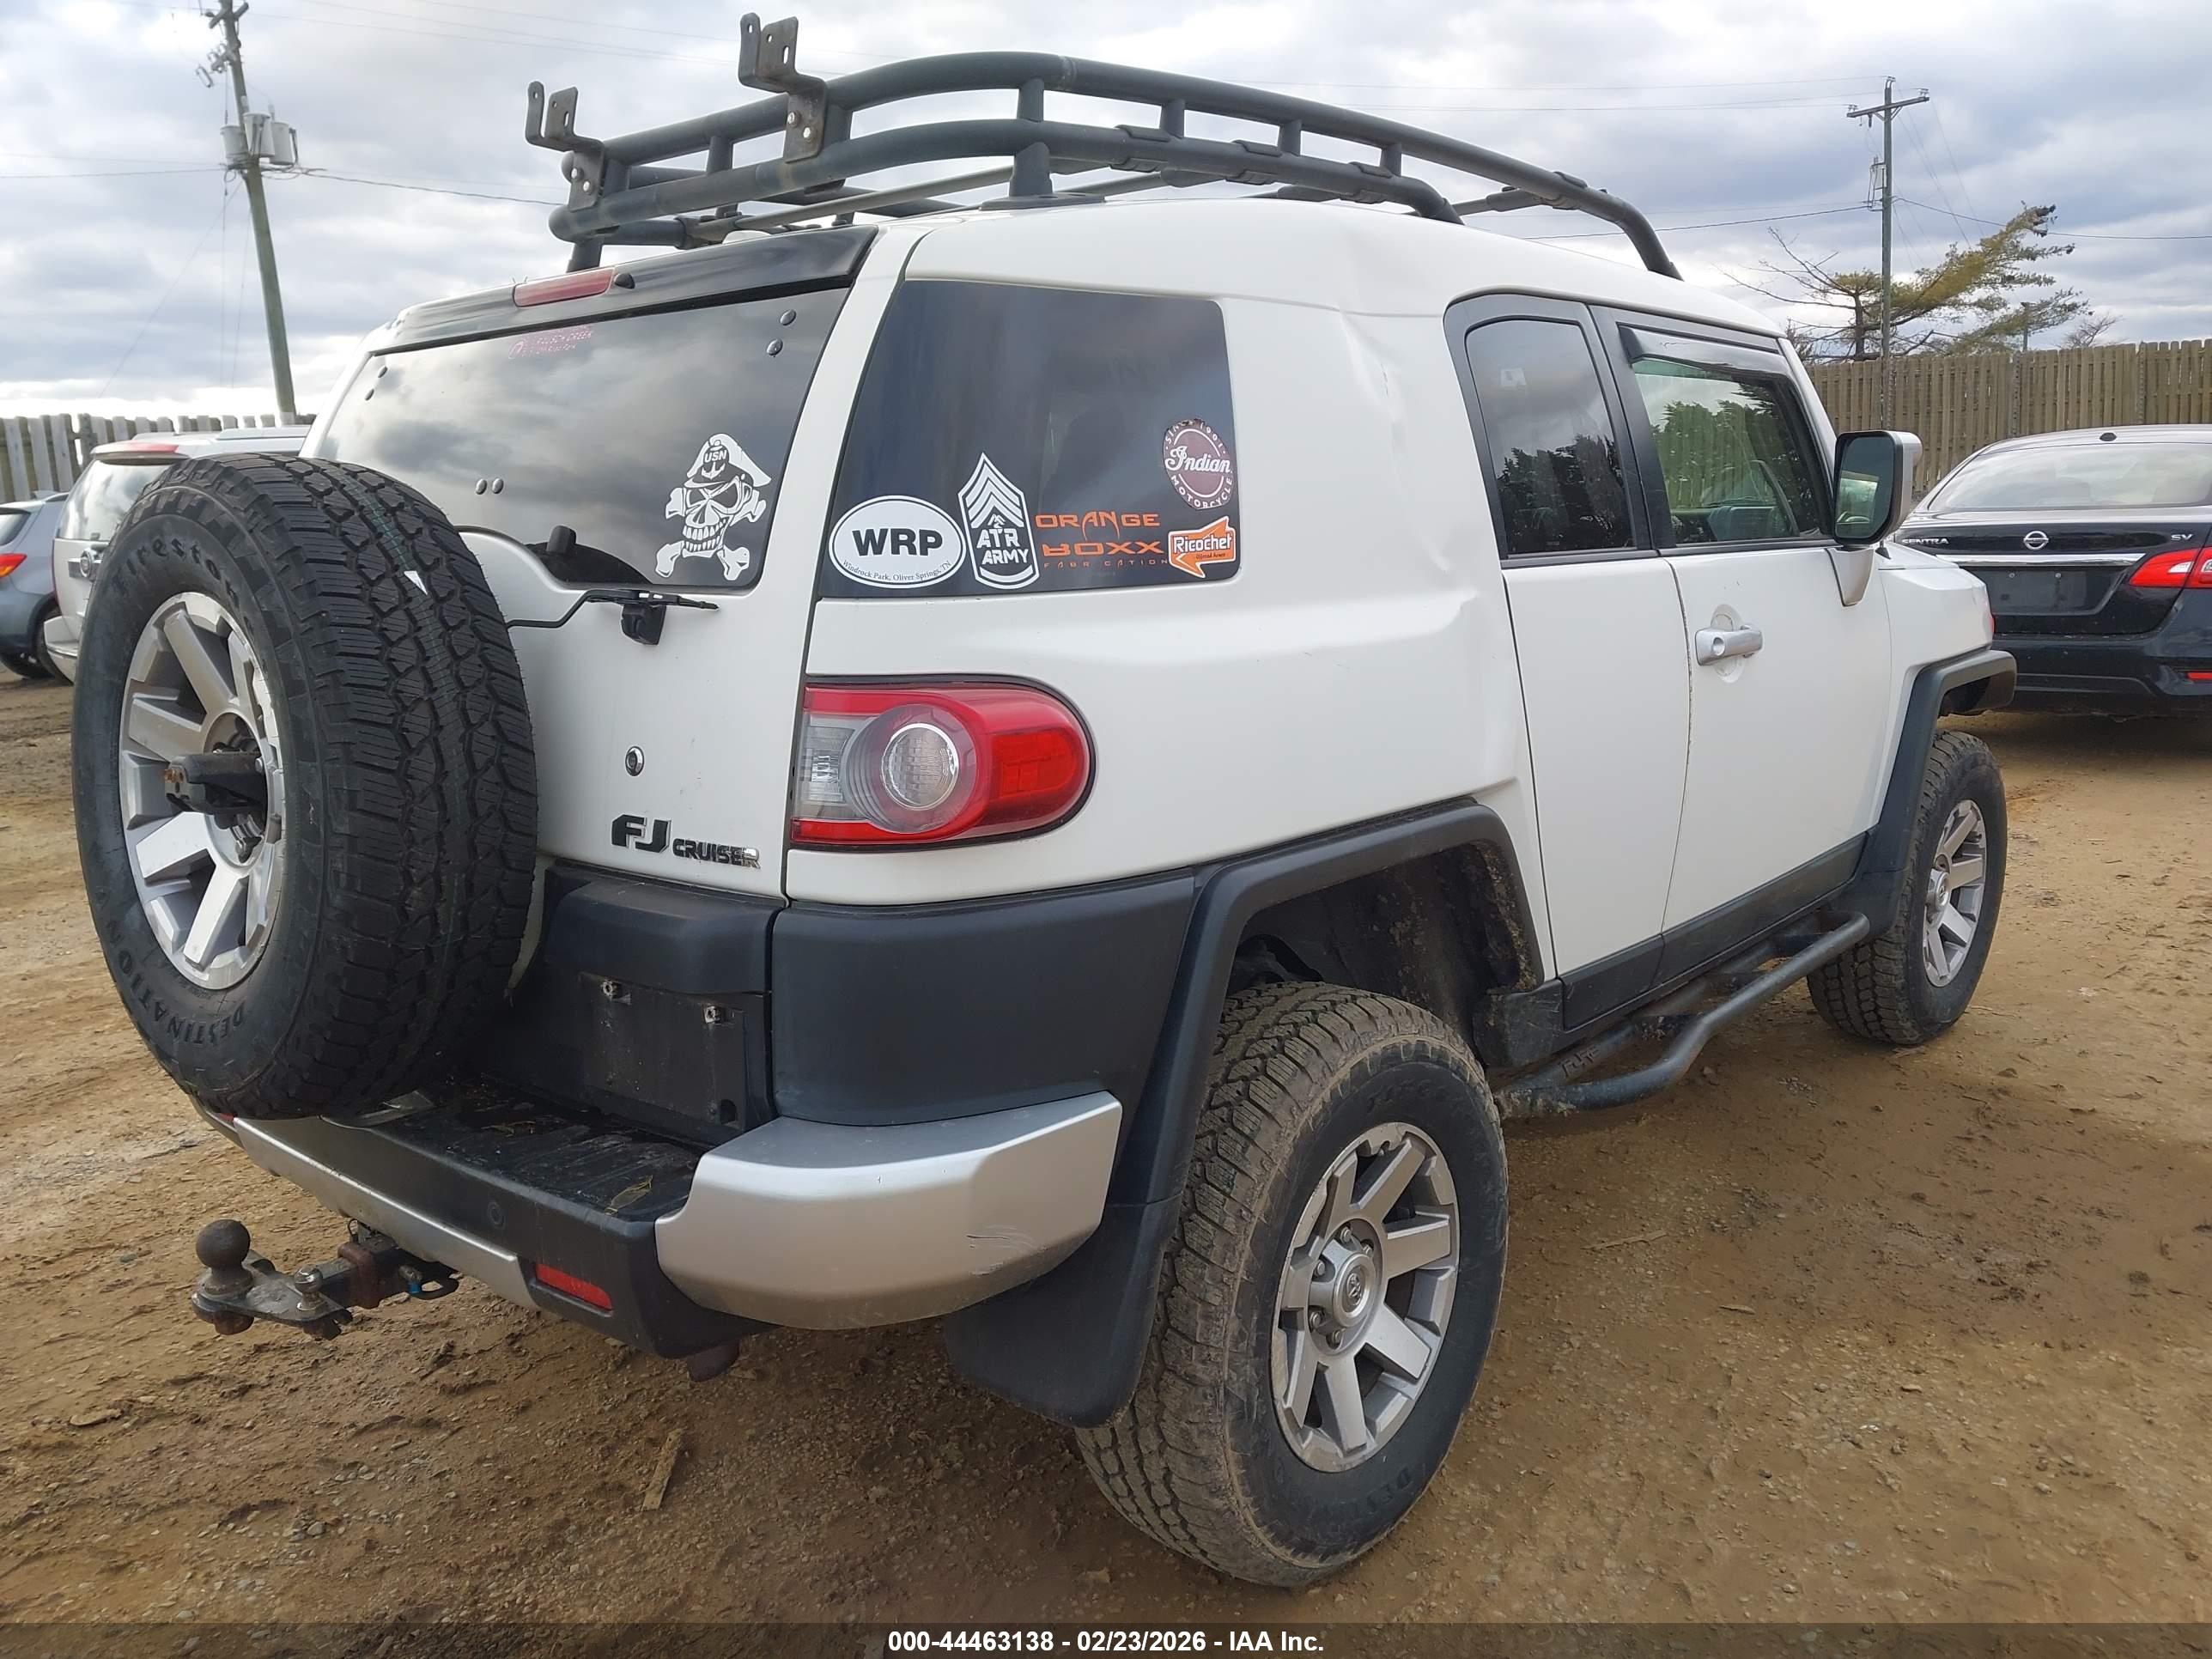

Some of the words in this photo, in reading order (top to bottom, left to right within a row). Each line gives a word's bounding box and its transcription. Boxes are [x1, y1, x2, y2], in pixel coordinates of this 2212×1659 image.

[704, 449, 727, 463] USN
[1164, 446, 1231, 472] Indian
[1171, 475, 1233, 508] MOTORCYCLE
[976, 528, 1020, 548] ATR
[1035, 511, 1160, 541] ORANGE
[852, 528, 943, 556] WRP
[1173, 532, 1232, 554] Ricochet
[981, 549, 1029, 565] ARMY
[842, 559, 874, 578] Windrock
[873, 572, 891, 581] Park,
[915, 568, 941, 581] Springs,
[939, 560, 952, 571] TN
[611, 814, 672, 854] FJ
[672, 837, 761, 870] CRUISER
